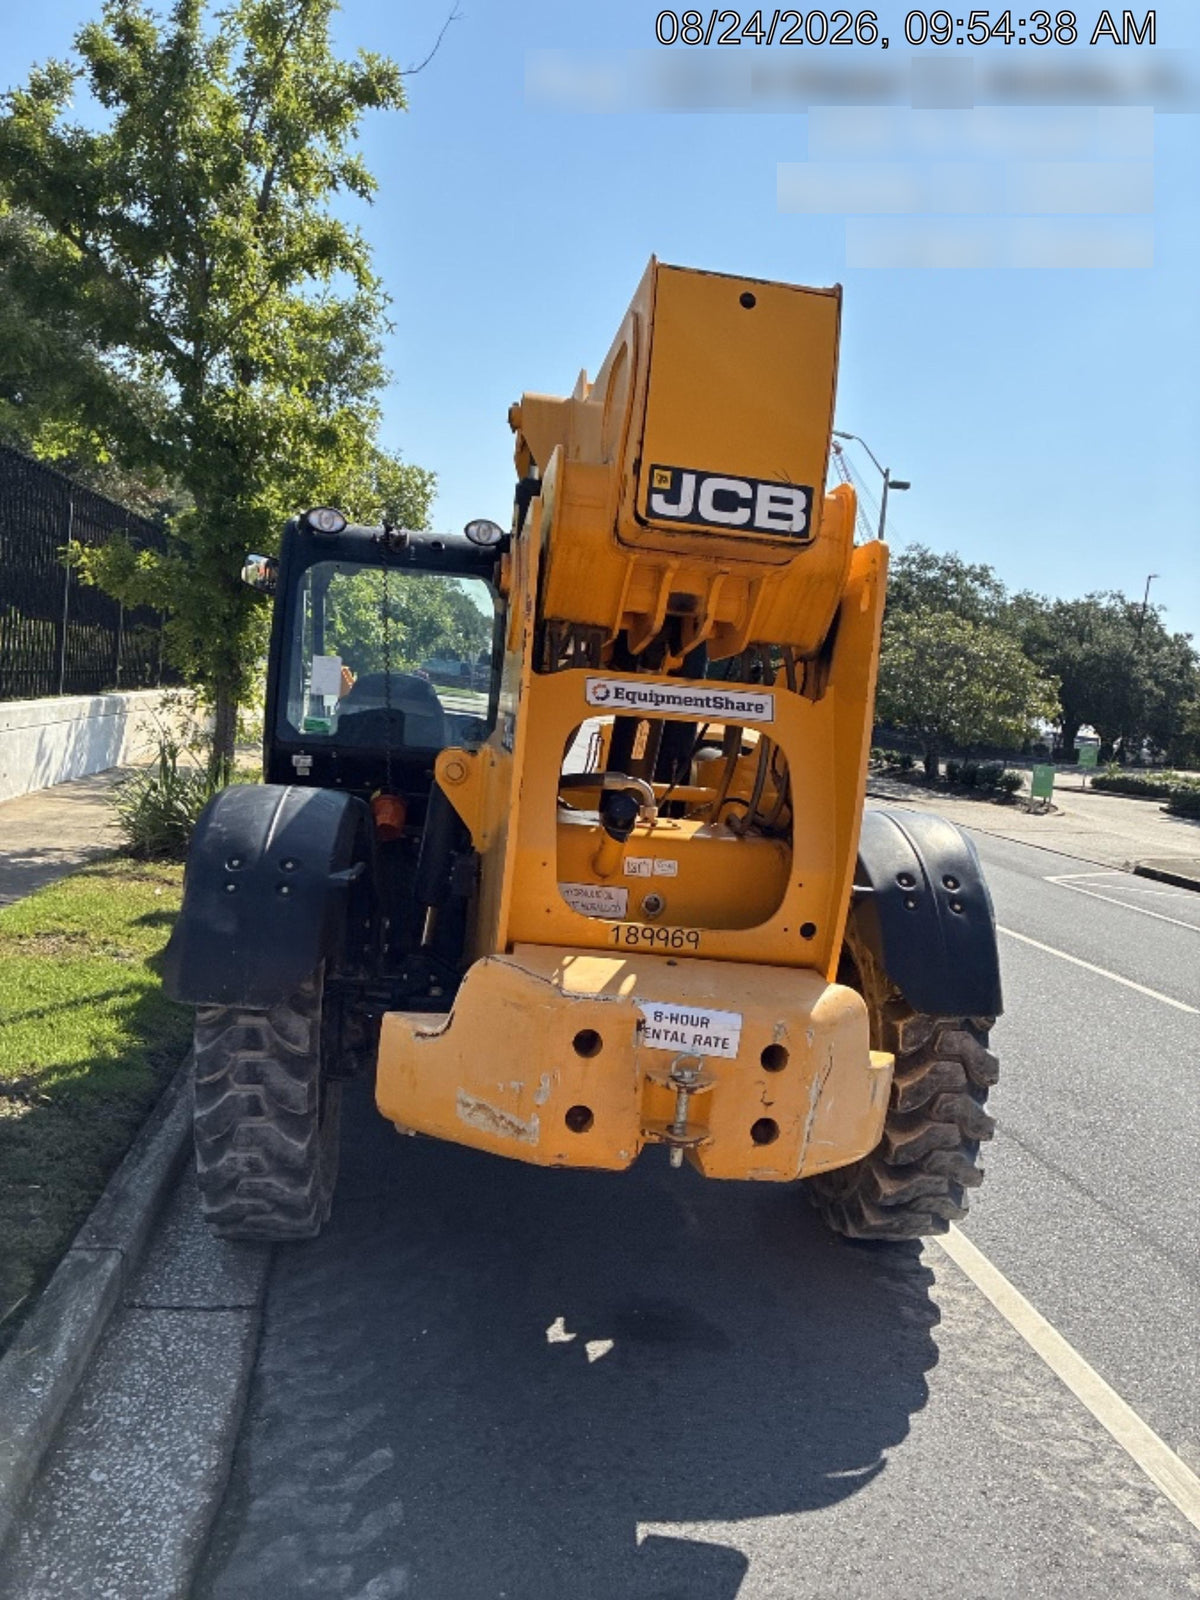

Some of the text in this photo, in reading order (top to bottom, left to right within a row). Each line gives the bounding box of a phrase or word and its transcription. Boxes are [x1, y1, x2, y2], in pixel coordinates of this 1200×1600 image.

[651, 473, 807, 533] JCB
[613, 686, 765, 714] EquipmentShare
[611, 925, 700, 950] 189969
[653, 1010, 710, 1029] 8-HOUR
[643, 1027, 730, 1050] ENTAL RATE
